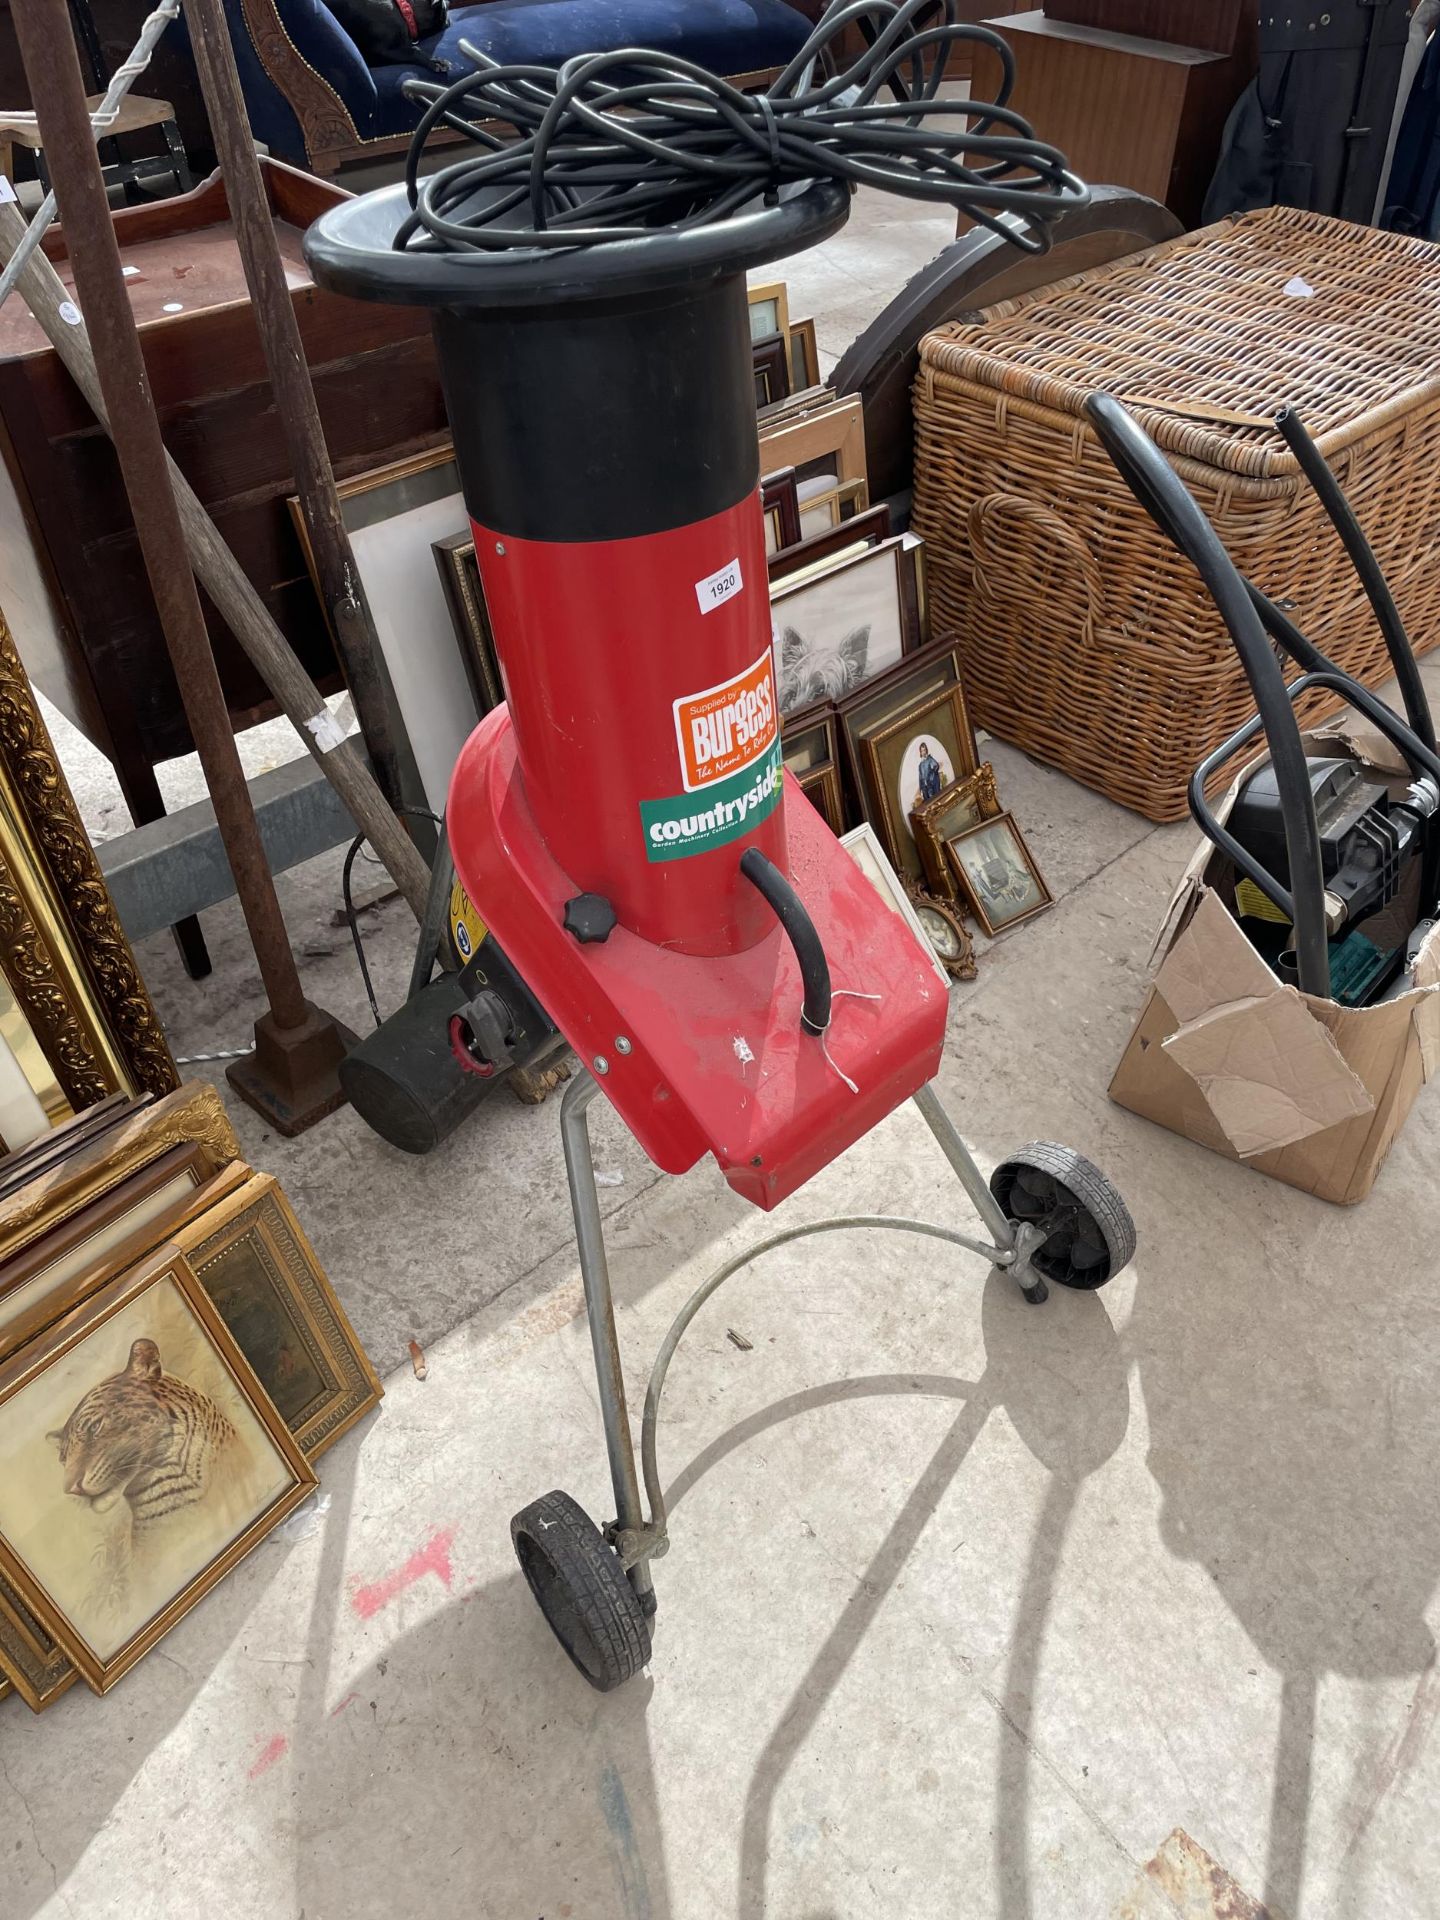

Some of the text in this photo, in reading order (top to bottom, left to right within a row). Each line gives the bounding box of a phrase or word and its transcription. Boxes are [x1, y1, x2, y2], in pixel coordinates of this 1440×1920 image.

[710, 574, 735, 598] 1920
[690, 692, 737, 716] Supplied by
[690, 674, 773, 766] Burgess
[696, 765, 712, 780] The
[715, 753, 741, 773] Name
[742, 745, 751, 757] To
[678, 833, 711, 844] Machinery
[711, 820, 739, 834] Collection
